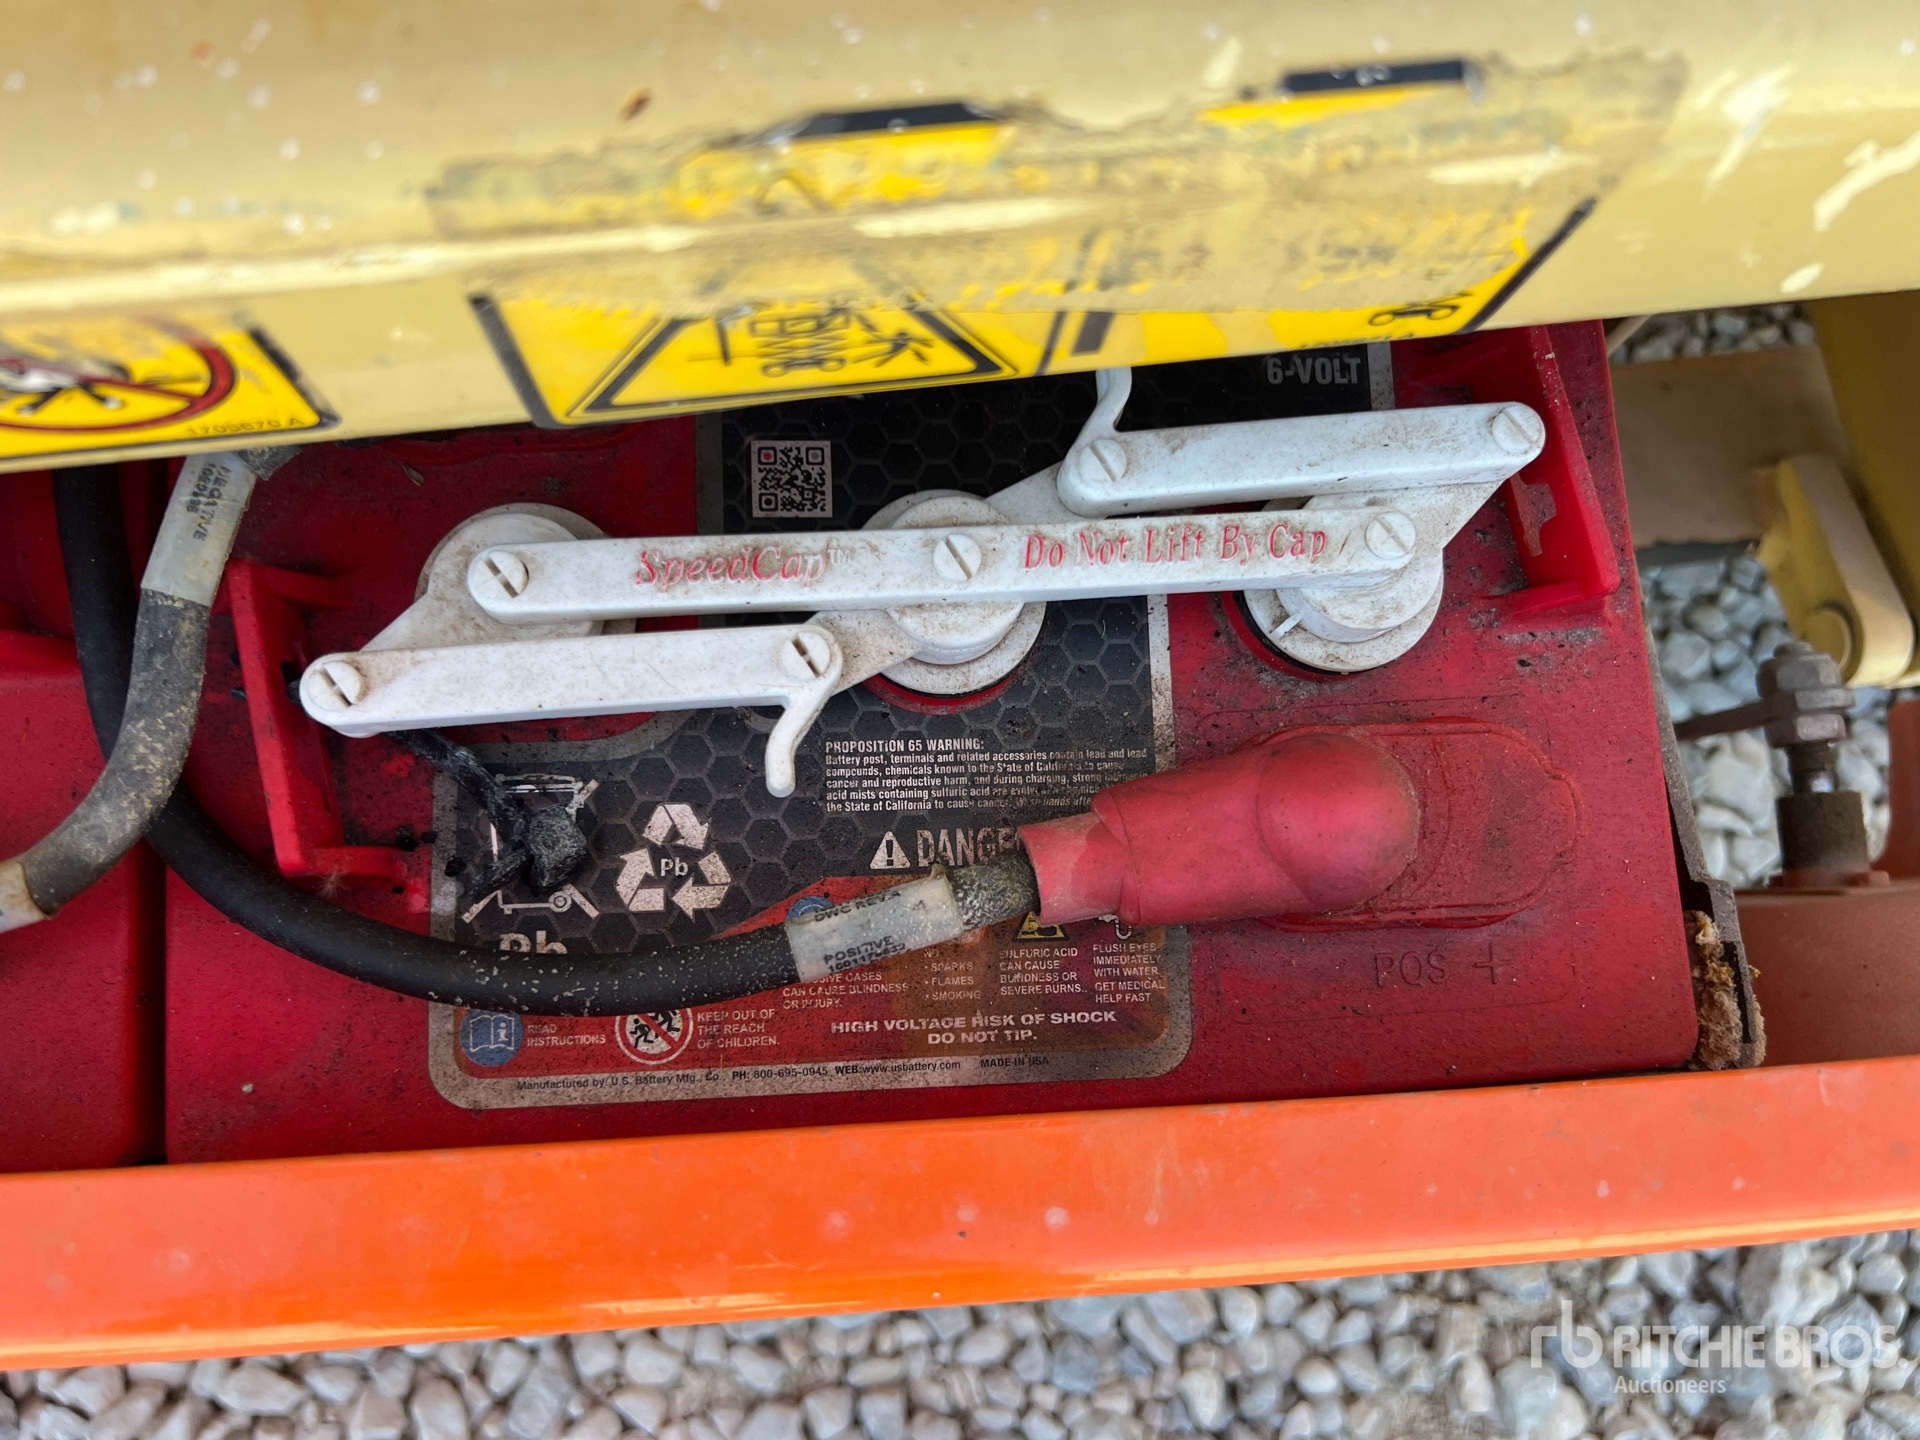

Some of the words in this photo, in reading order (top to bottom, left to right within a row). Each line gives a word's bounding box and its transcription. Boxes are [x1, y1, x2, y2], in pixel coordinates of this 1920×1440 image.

[1266, 357, 1361, 385] 6-VOLT
[289, 417, 305, 426] A
[193, 465, 232, 541] NEGATIVE
[1024, 533, 1065, 571] Do
[1076, 530, 1129, 567] Not
[1143, 525, 1204, 565] Lift
[1219, 524, 1260, 565] By
[1267, 522, 1328, 564] Cap
[826, 740, 904, 753] PROPOSITION
[908, 740, 922, 751] 65
[927, 738, 984, 751] WARNING:
[826, 755, 860, 766] Battery
[864, 754, 887, 766] post,
[890, 753, 934, 764] terminals
[937, 752, 954, 763] and
[957, 751, 990, 762] related
[993, 751, 1047, 761] accessories
[1086, 749, 1105, 758] lead
[1108, 748, 1124, 758] and
[1127, 748, 1147, 758] lead
[826, 766, 882, 777] compounds,
[885, 765, 932, 776] chemicals
[935, 764, 965, 774] known
[967, 764, 977, 773] to
[979, 763, 995, 773] the
[997, 762, 1023, 772] State
[1025, 761, 1034, 772] of
[1097, 761, 1124, 770] cause
[826, 778, 859, 788] cancer
[862, 777, 880, 788] and
[882, 776, 942, 789] reproductive
[944, 775, 971, 786] harm,
[974, 775, 990, 784] and
[993, 774, 1023, 785] during
[1026, 773, 1070, 786] charging,
[1072, 772, 1101, 783] strong
[826, 789, 847, 800] acid
[850, 789, 876, 800] mists
[878, 788, 929, 800] containing
[931, 787, 968, 797] sulfuric
[970, 786, 990, 797] acid
[992, 787, 1008, 796] are
[826, 801, 842, 812] the
[845, 801, 870, 812] State
[873, 800, 882, 811] of
[886, 799, 931, 811] California
[935, 800, 943, 809] to
[947, 800, 974, 809] cause
[1073, 795, 1092, 806] afte
[917, 827, 1020, 867] DANGE
[660, 858, 689, 877] Pb
[823, 936, 894, 965] POSITIVE
[924, 949, 939, 957] NO
[1000, 948, 1050, 959] SULFURIC
[1053, 947, 1078, 957] ACID
[1093, 943, 1126, 953] FLUSH
[1129, 943, 1157, 952] EYES
[931, 962, 973, 972] SPARKS
[1000, 961, 1022, 971] CAN
[1025, 960, 1060, 970] CAUSE
[1093, 955, 1161, 966] IMMEDIATELY
[1063, 972, 1078, 982] OR
[1094, 967, 1120, 977] WITH
[931, 976, 974, 986] FLAMES
[1119, 980, 1165, 990] MEDICAL
[809, 985, 846, 995] CAUSE
[932, 990, 981, 1001] SMOKING
[1000, 985, 1042, 996] SEVERE
[1095, 993, 1122, 1003] HELP
[1125, 992, 1151, 1003] FAST
[783, 1000, 799, 1009] OR
[697, 1011, 728, 1022] KEEP
[732, 1010, 757, 1020] OUT
[760, 1009, 775, 1019] OF
[528, 1024, 557, 1034] READ
[697, 1025, 720, 1036] THE
[724, 1022, 765, 1034] REACH
[831, 1020, 878, 1034] HIGH
[884, 1017, 966, 1031] VOLTAGE
[971, 1014, 1015, 1028] RISK
[1020, 1013, 1045, 1026] OF
[1050, 1011, 1117, 1025] SHOCK
[527, 1034, 606, 1047] INSTRUCTIONS
[697, 1039, 713, 1049] OF
[718, 1035, 780, 1048] CHILDREN.
[928, 1032, 955, 1045] DO
[961, 1030, 998, 1044] NOT
[1004, 1029, 1037, 1042] TIP.
[980, 1058, 1011, 1068] MADE
[1014, 1057, 1025, 1066] IN
[1028, 1056, 1050, 1065] USA
[517, 1078, 589, 1090] Manufactured
[635, 1075, 674, 1086] Battery
[732, 1070, 750, 1080] PH:
[753, 1066, 828, 1079] 800-695-0945
